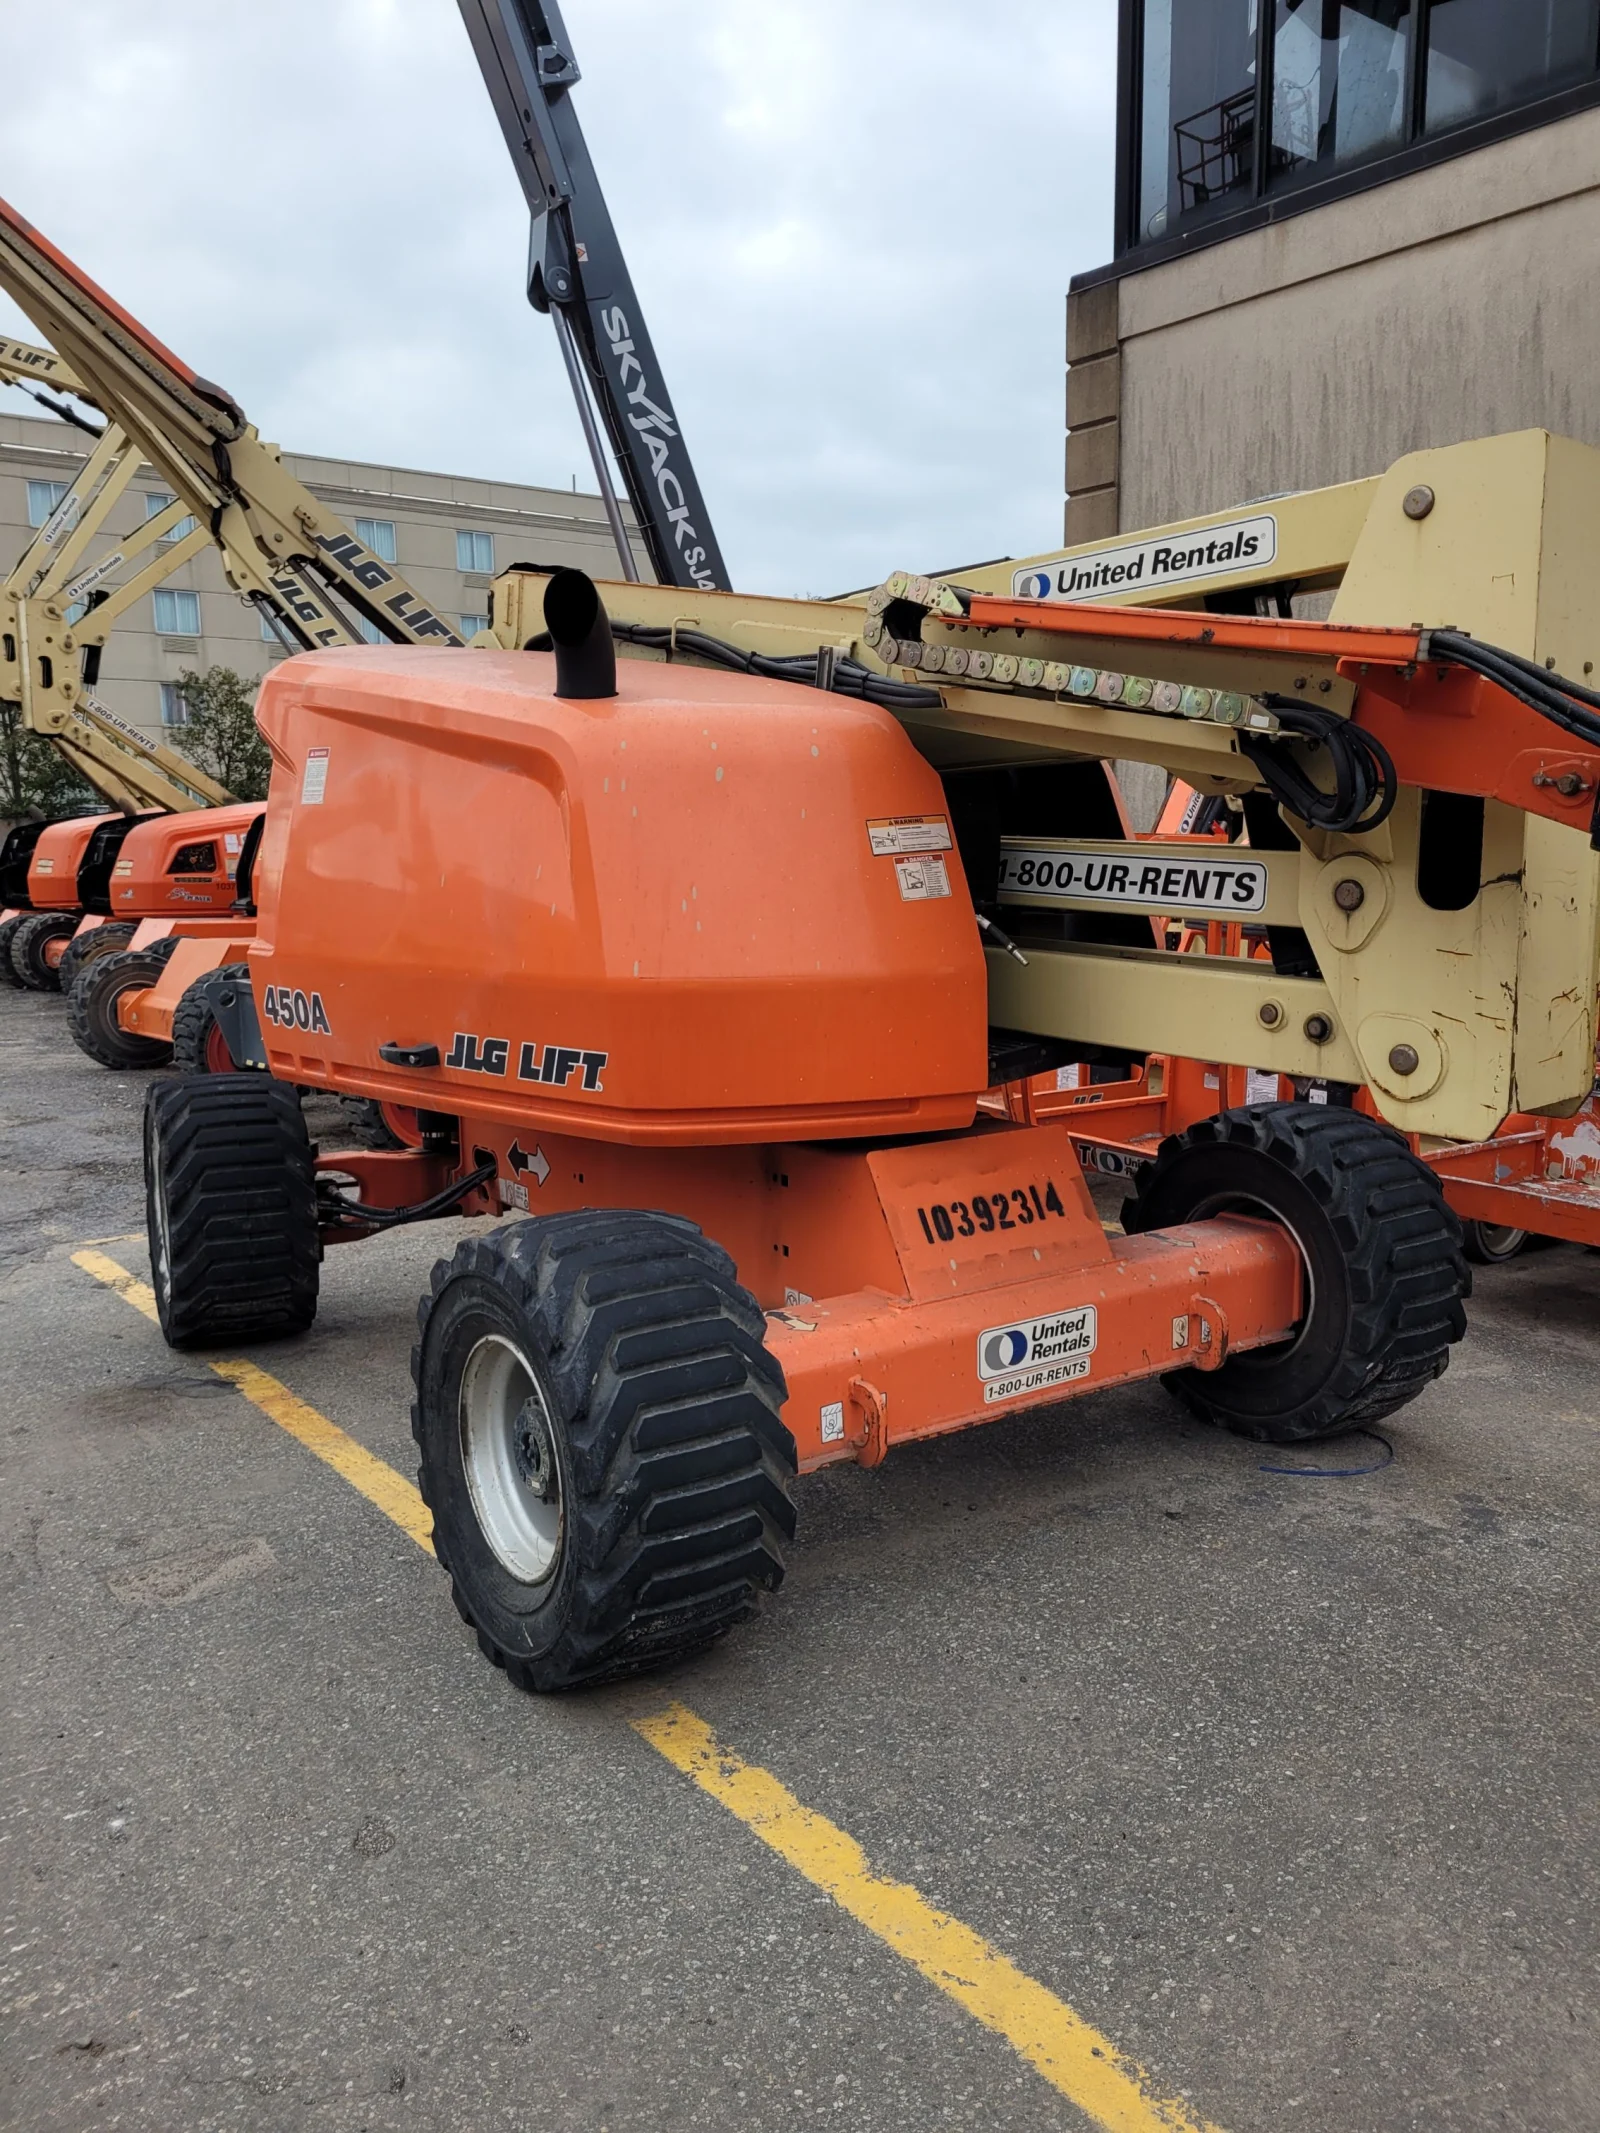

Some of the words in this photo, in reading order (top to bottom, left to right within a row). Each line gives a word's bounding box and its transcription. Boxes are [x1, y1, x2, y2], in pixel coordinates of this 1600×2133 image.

[11, 347, 58, 371] LIFT
[601, 306, 697, 550] SKYJACK
[51, 516, 64, 538] United
[62, 497, 78, 518] Rentals
[77, 571, 100, 591] United
[98, 556, 122, 575] Rentals
[315, 532, 394, 591] JLG
[1056, 553, 1145, 594] United
[1151, 531, 1260, 575] Rentals
[268, 576, 324, 623] JLG
[88, 701, 157, 751] 1-800-UR-RENTS
[894, 817, 924, 826] WARNING
[909, 855, 934, 863] DANGER
[999, 858, 1257, 903] 1-800-UR-RENTS
[264, 984, 332, 1036] 450A
[445, 1032, 510, 1077] JLG
[517, 1042, 608, 1092] LIFT
[917, 1181, 1065, 1244] 10392314
[1031, 1313, 1087, 1342] United
[1031, 1333, 1091, 1361] Rentals
[988, 1361, 1087, 1398] 1-800-UR-RENTS
